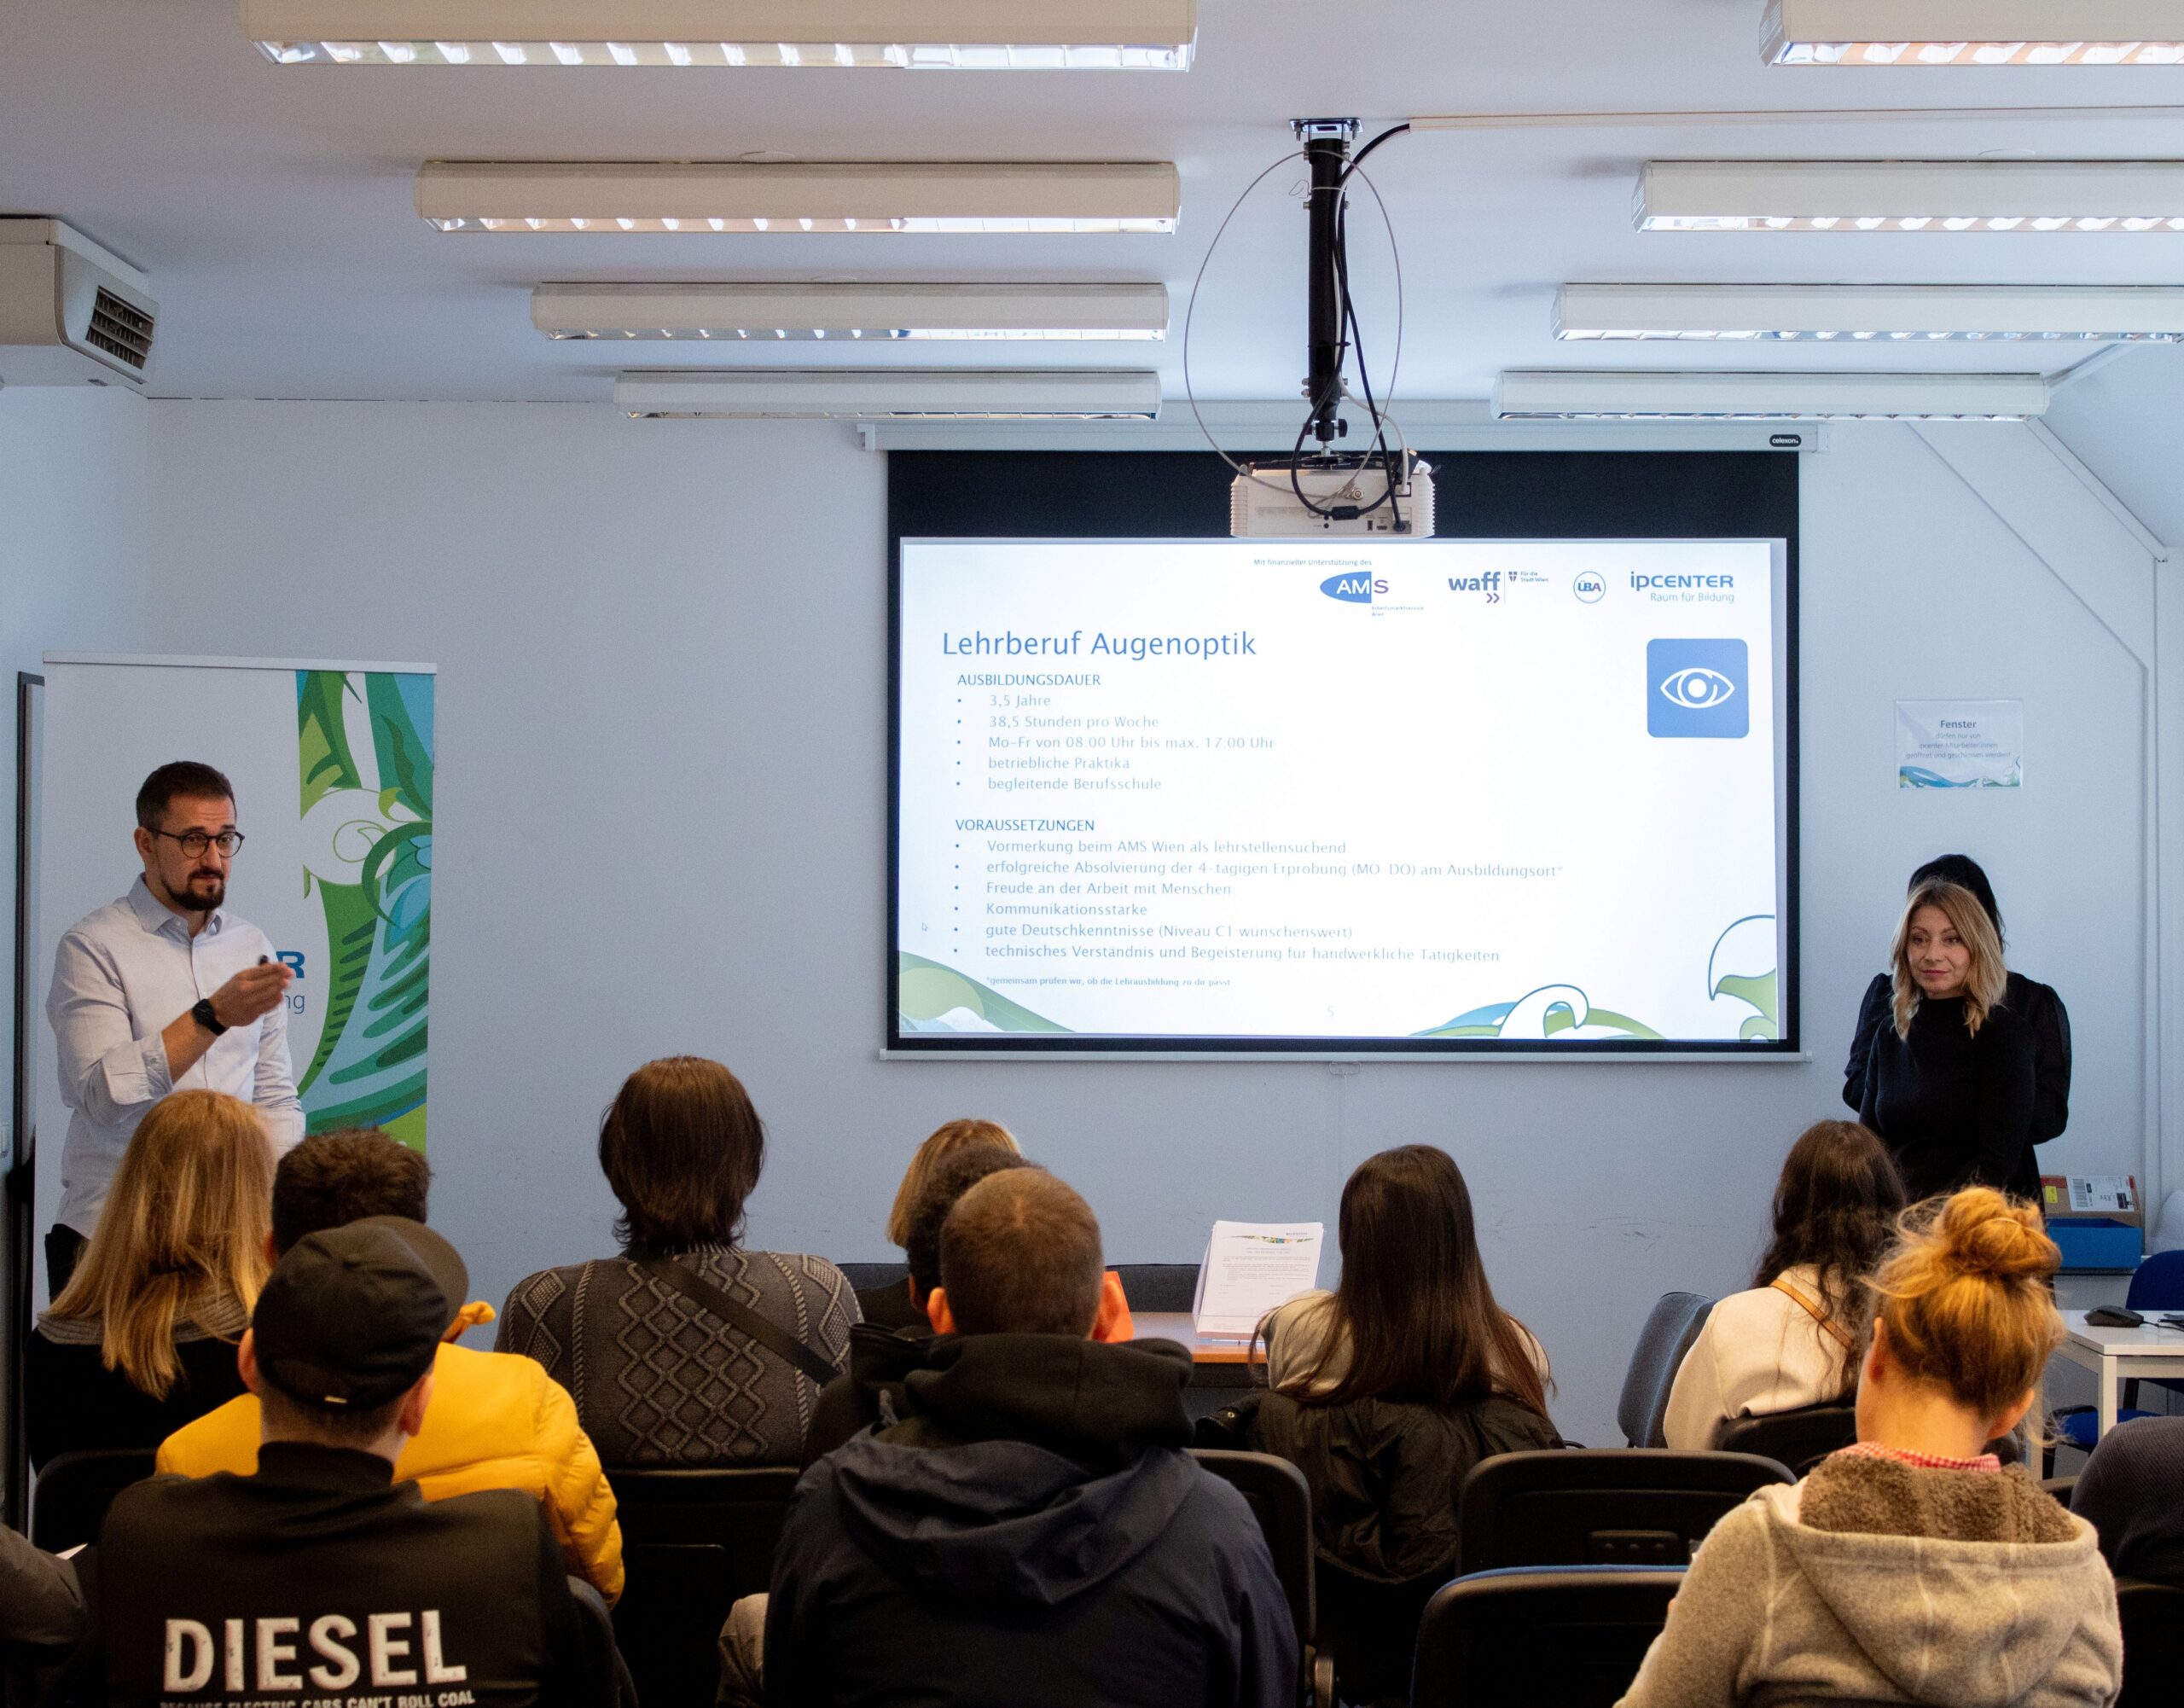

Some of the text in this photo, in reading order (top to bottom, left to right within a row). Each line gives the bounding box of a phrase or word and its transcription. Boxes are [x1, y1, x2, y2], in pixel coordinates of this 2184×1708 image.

[1336, 579, 1389, 594] AMS
[1448, 572, 1501, 591] waff
[1650, 592, 1734, 604] Raum für Bildung
[943, 630, 1257, 661] Lehrberuf Augenoptik
[956, 673, 1101, 688] AUSBILDUNGSDAUER
[990, 694, 1050, 709] 3,5 Jahre
[990, 715, 1159, 729] 38,5 Stunden pro Woche
[1940, 720, 1977, 729] Fenster
[1036, 739, 1060, 748] von
[1112, 737, 1134, 747] Uhr
[1141, 736, 1159, 748] bis
[1166, 740, 1198, 748] max.
[1251, 737, 1273, 748] Uhr
[989, 756, 1130, 769] betriebliche Praktika
[988, 777, 1160, 792] begleitende Berufsschule
[956, 818, 1095, 833] VORAUSSETZUNGEN
[987, 839, 1345, 855] Vormerkung beim AMS Wien als lehrstellensuchend
[986, 860, 1069, 875] erfolgreiche
[1074, 860, 1165, 876] Absolvierung
[1170, 862, 1192, 874] der
[1274, 863, 1346, 877] Erprobung
[1421, 867, 1441, 875] am
[986, 881, 1230, 894] Freude an der Arbeit mit Menschen
[986, 926, 1017, 938] gute
[1022, 923, 1153, 938] Deutschkenntnisse
[1159, 924, 1210, 938] (Niveau
[1215, 926, 1231, 937] C1
[985, 944, 1066, 959] technisches
[1159, 945, 1186, 958] und
[1191, 946, 1281, 961] Begeisterung
[1313, 947, 1414, 960] handwerkliche
[1087, 977, 1098, 985] ob
[1100, 977, 1113, 985] die
[1114, 977, 1179, 987] Lehrausbildung
[164, 1609, 468, 1692] DIESEL
[438, 1690, 475, 1706] COAL
